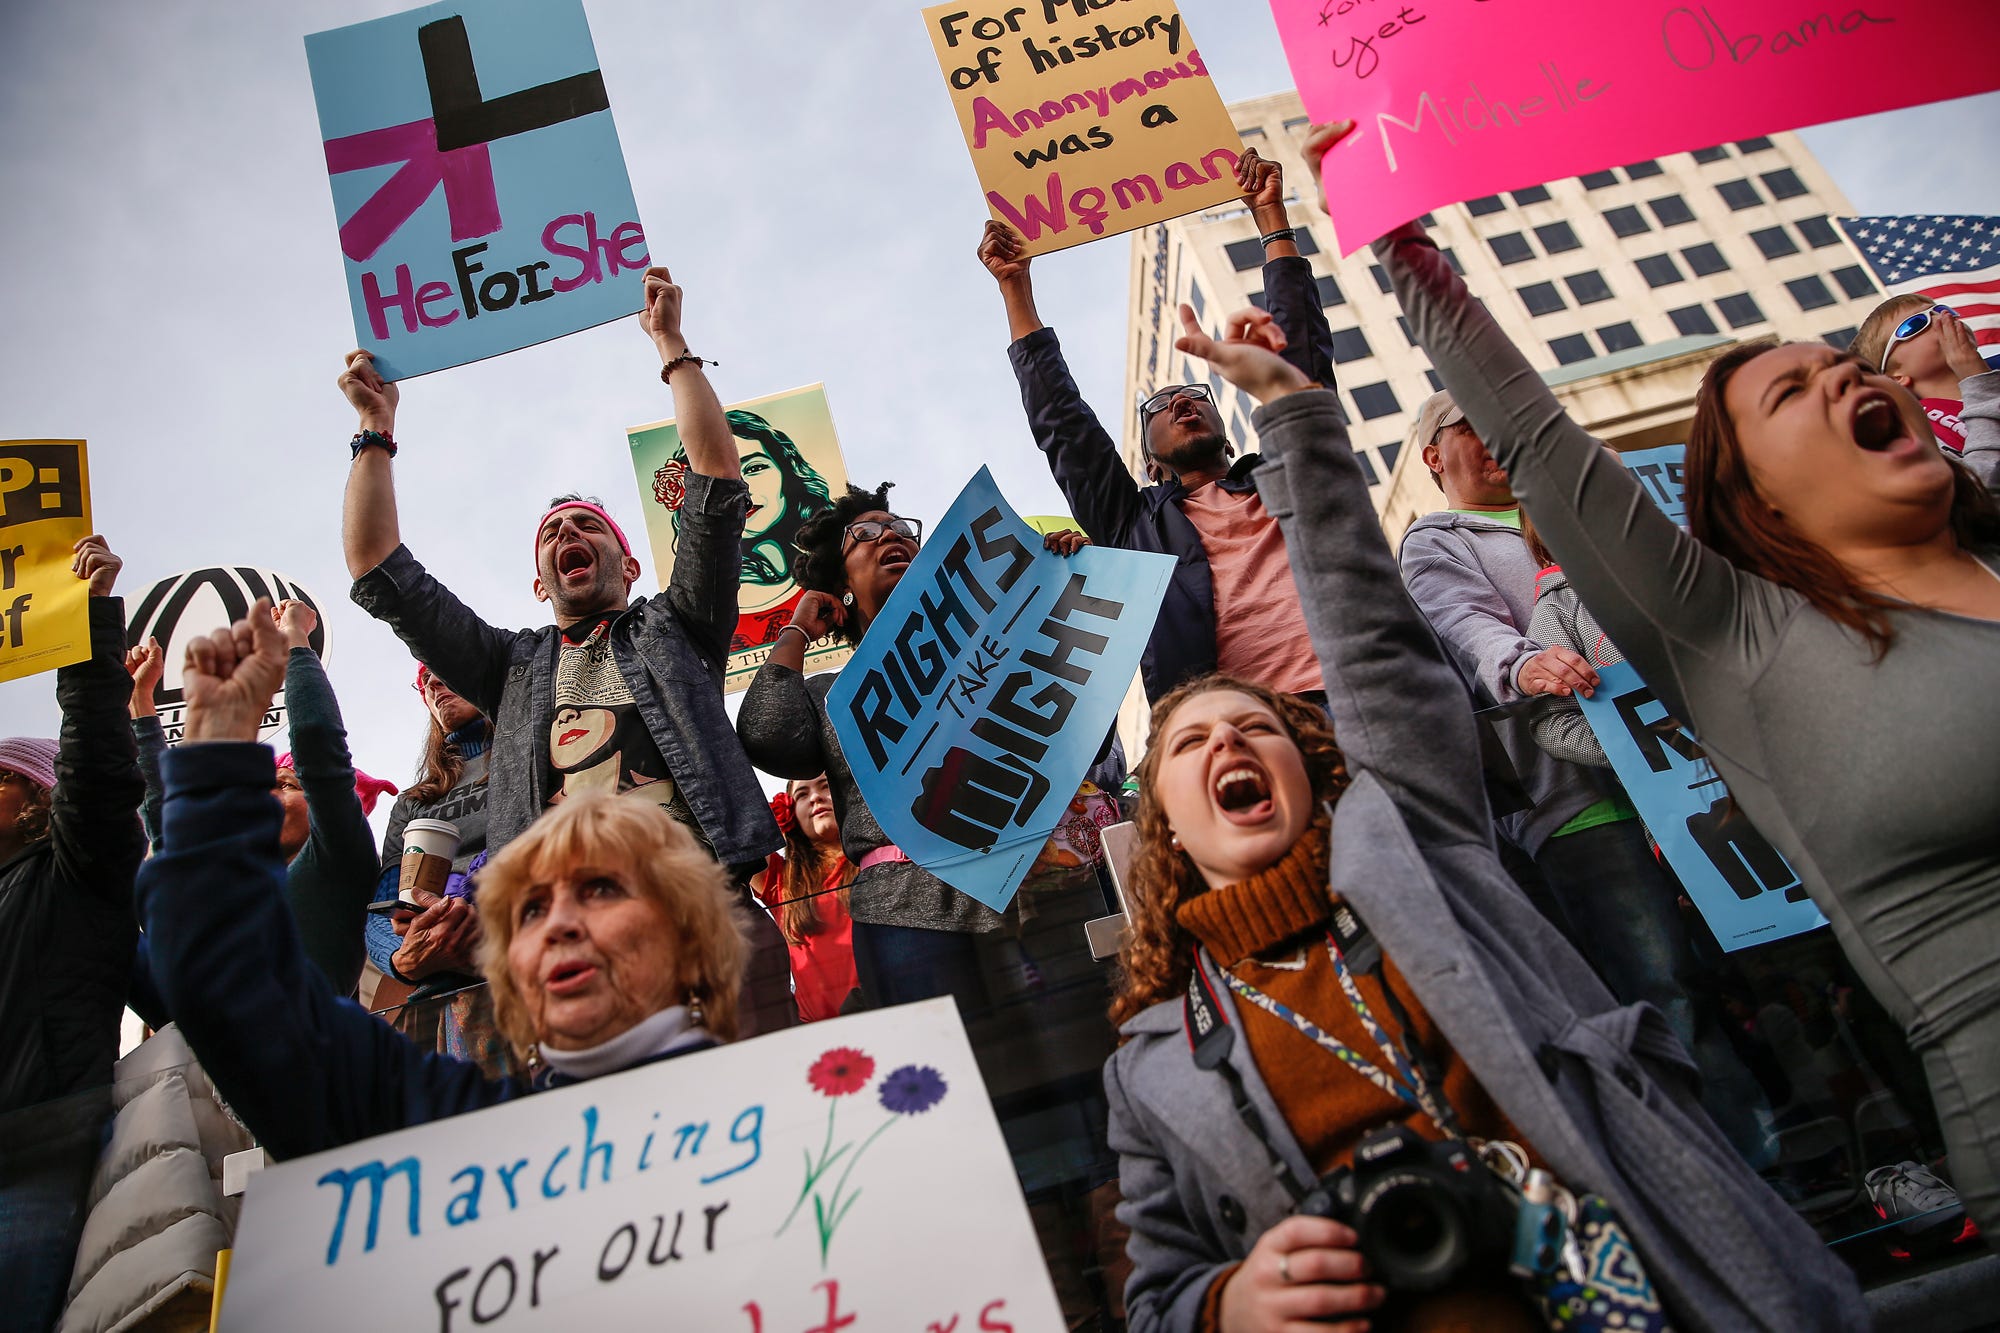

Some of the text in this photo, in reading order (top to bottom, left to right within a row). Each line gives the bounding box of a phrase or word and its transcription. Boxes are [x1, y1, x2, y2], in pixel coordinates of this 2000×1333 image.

[940, 7, 1026, 47] For
[951, 14, 1181, 90] of history
[1333, 7, 1426, 79] yet
[1662, 5, 1897, 72] Obama
[973, 49, 1210, 149] Anonymous
[1013, 104, 1179, 169] was a
[987, 148, 1243, 242] Woman
[849, 506, 1036, 774] RIGHTS
[937, 635, 1010, 719] TAKE
[317, 1105, 765, 1267] Marching
[597, 1199, 730, 1283] our
